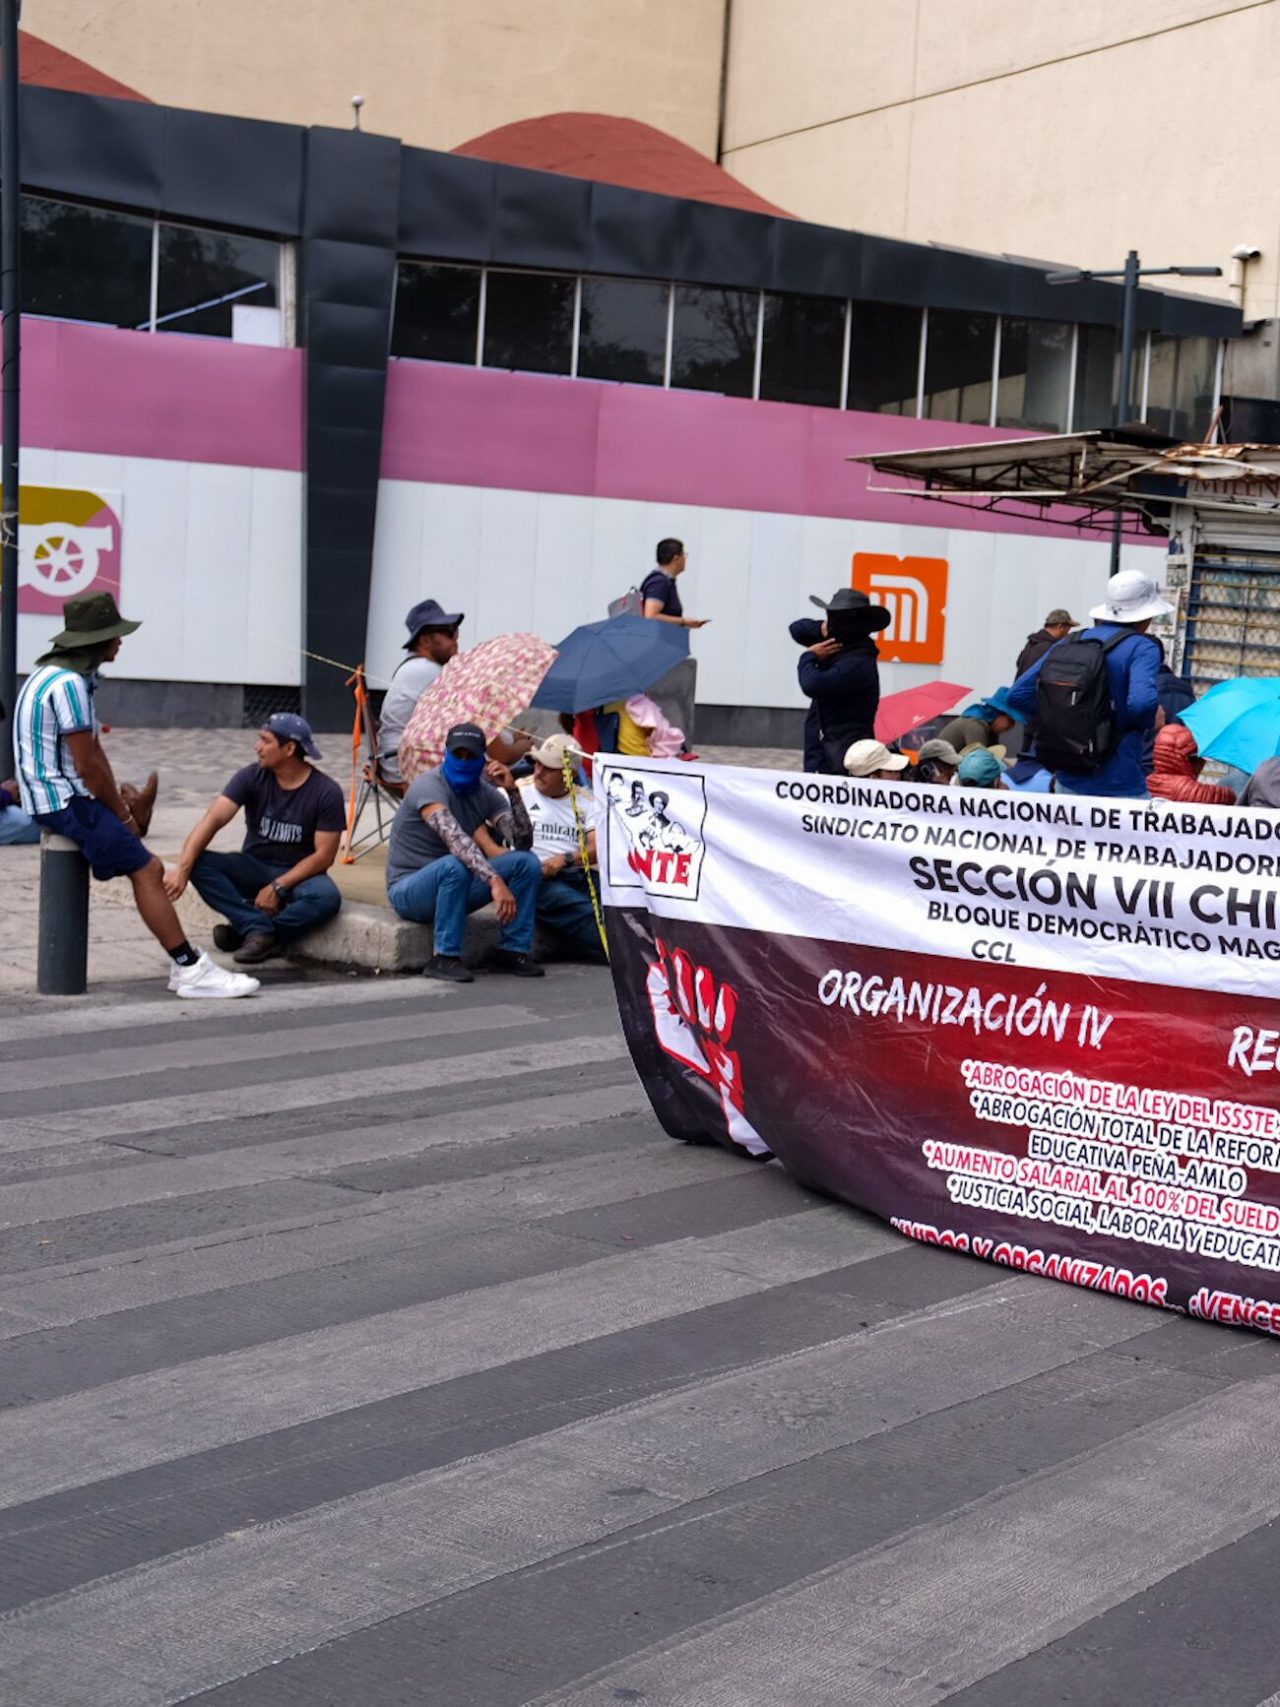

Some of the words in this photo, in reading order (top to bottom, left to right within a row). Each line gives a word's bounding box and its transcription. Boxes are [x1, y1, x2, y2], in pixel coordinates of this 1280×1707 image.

[775, 781, 953, 815] COORDINADORA
[959, 795, 1085, 826] NACIONAL
[1091, 808, 1120, 829] DE
[802, 815, 919, 843] SINDICATO
[924, 829, 1048, 857] NACIONAL
[1056, 841, 1086, 860] DE
[910, 856, 1098, 910] SECCIÓN
[1114, 876, 1174, 918] VII
[928, 902, 1020, 930] BLOQUE
[1028, 913, 1211, 951] DEMOCRÁTICO
[971, 940, 1016, 962] CCL
[818, 968, 1070, 1042] ORGANIZACIÓN
[1090, 1086, 1113, 1106] DE
[1117, 1091, 1137, 1110] LA
[1143, 1094, 1174, 1118] LEY
[1179, 1101, 1211, 1122] DEL
[1217, 1107, 1274, 1132] ISSSTE
[1100, 1117, 1156, 1146] TOTAL
[1161, 1129, 1182, 1149] DE
[1187, 1132, 1210, 1154] LA
[1031, 1132, 1126, 1171] EDUCATIVA
[1131, 1152, 1244, 1193] PEÑA-AMLO
[1020, 1164, 1099, 1195] SALARIAL
[1106, 1178, 1126, 1200] AL
[1132, 1184, 1181, 1210] 100%
[1187, 1194, 1216, 1218] DEL
[1028, 1194, 1095, 1230] SOCIAL,
[1100, 1209, 1184, 1244] LABORAL
[1189, 1231, 1199, 1250] Y
